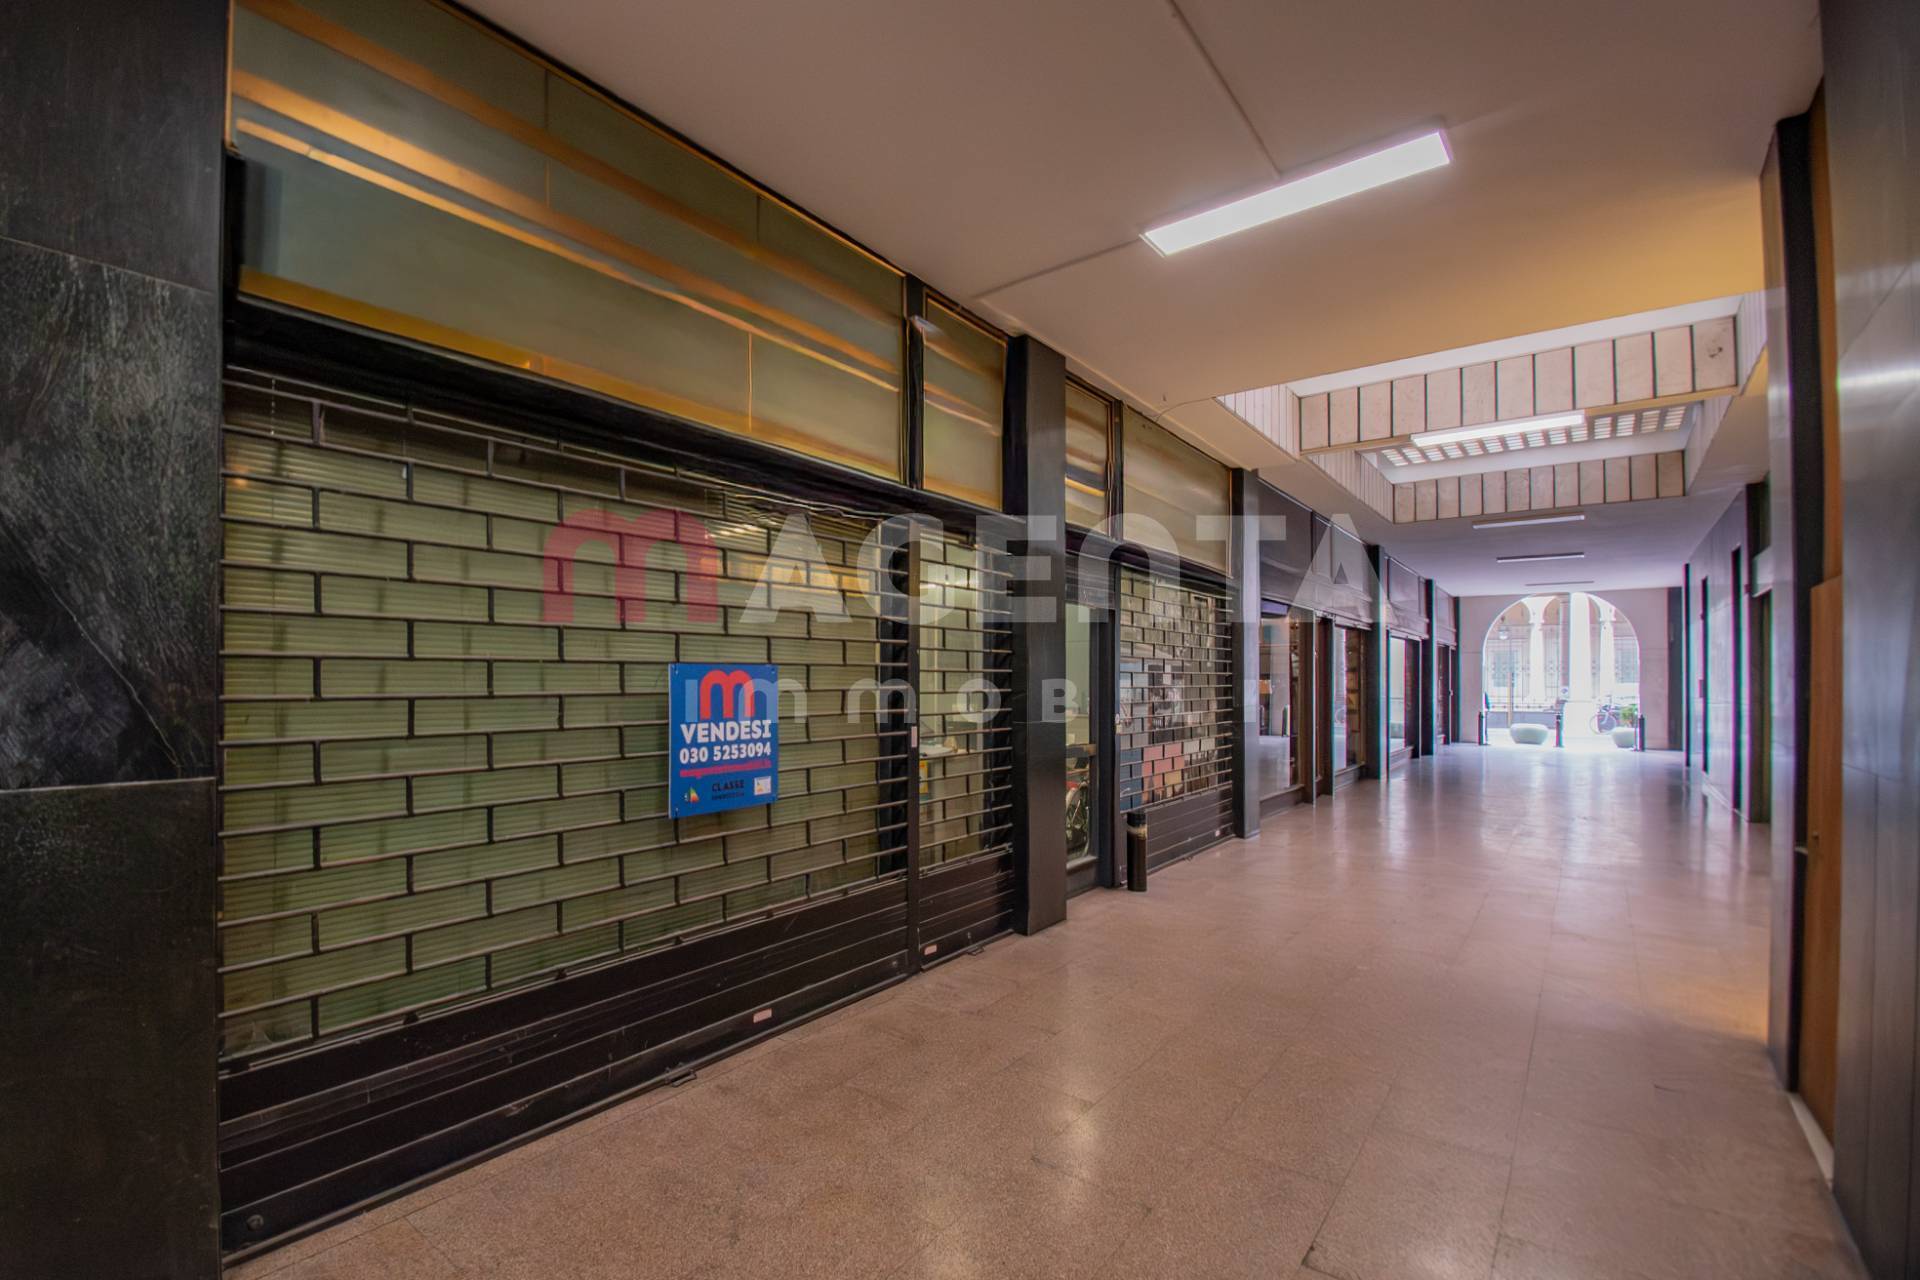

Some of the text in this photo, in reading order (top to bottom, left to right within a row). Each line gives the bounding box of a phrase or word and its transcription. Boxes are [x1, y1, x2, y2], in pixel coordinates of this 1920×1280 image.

[680, 720, 772, 744] VENDESI
[679, 742, 772, 765] 030 5253094
